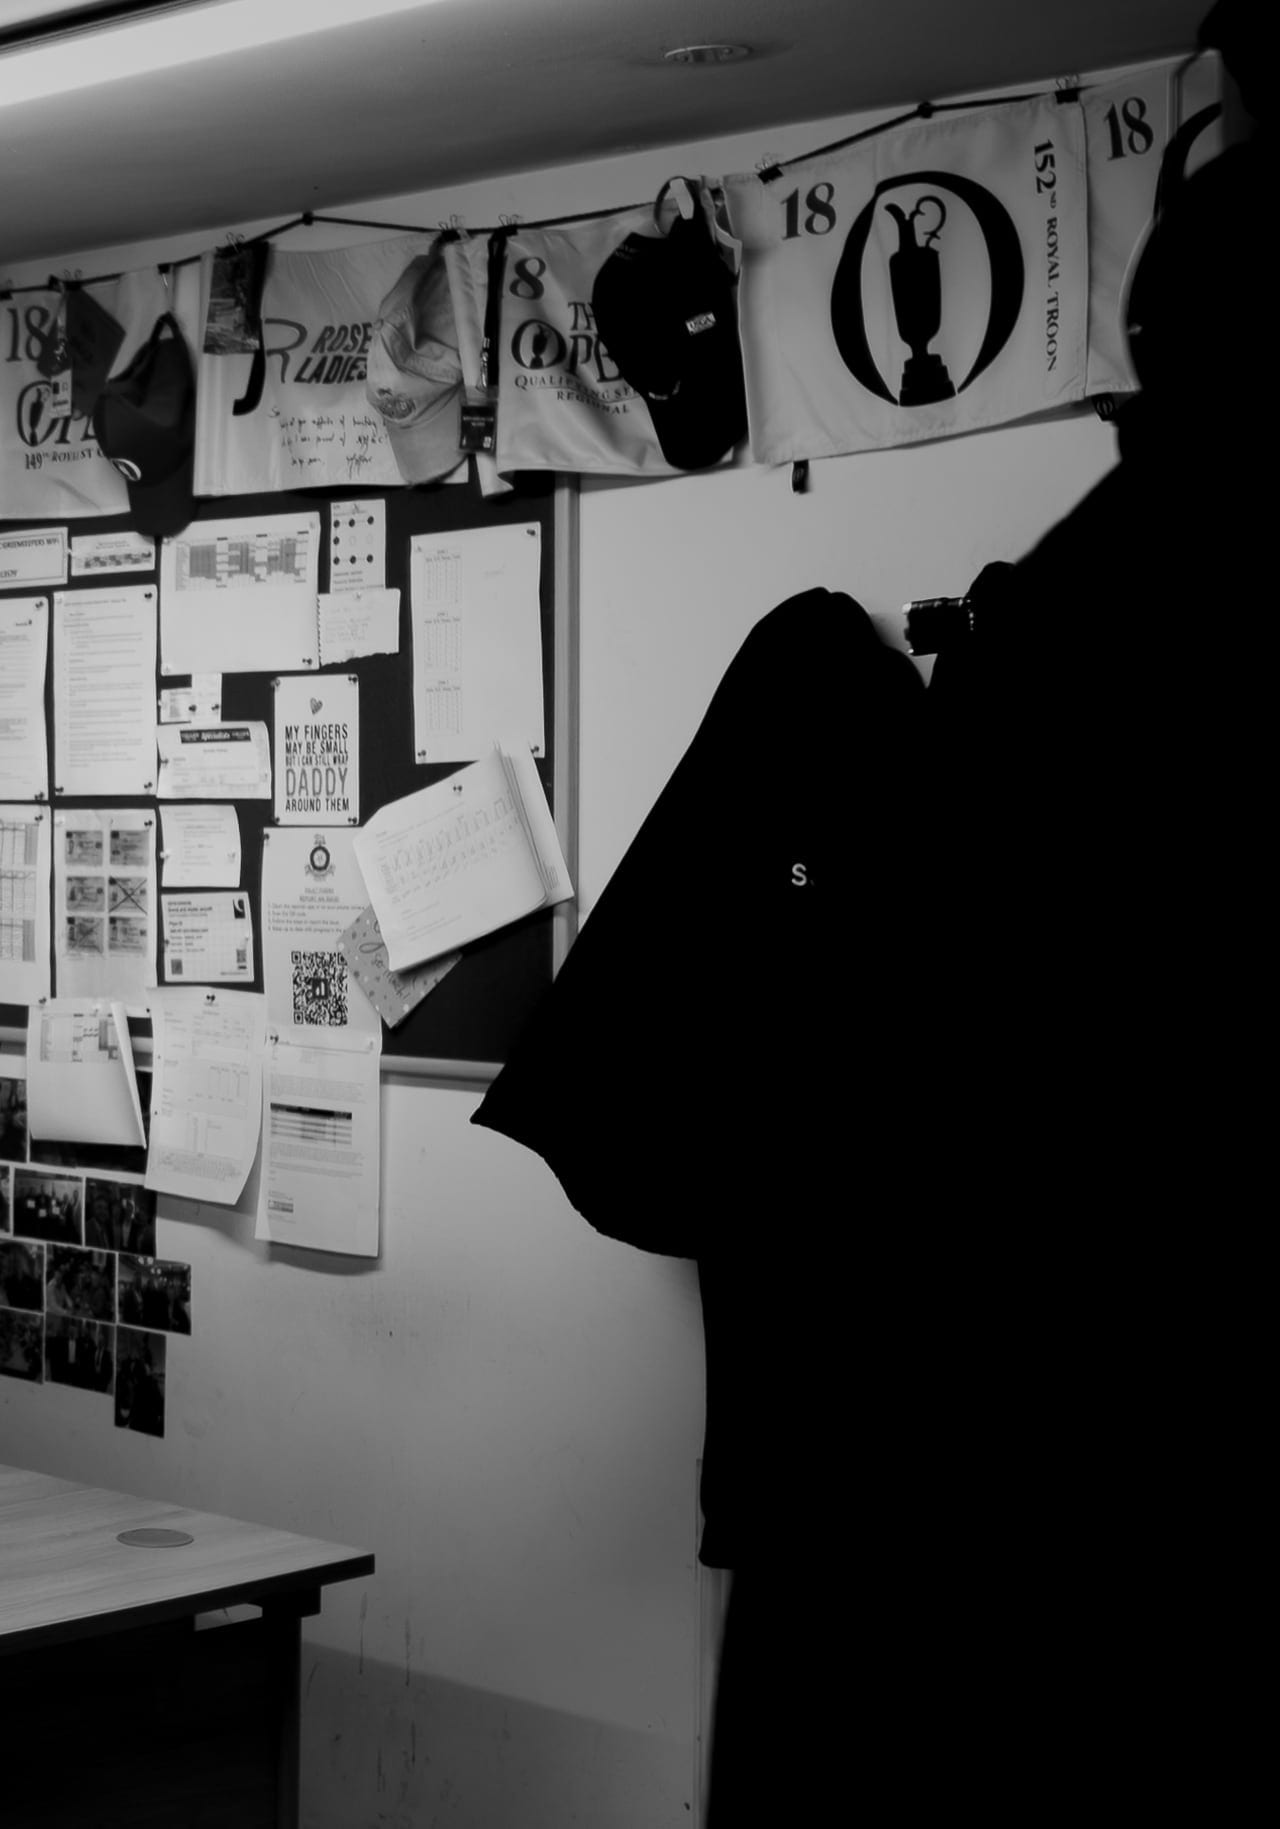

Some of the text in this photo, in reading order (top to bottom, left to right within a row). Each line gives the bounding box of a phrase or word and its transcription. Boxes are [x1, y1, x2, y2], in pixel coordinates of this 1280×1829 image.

[1104, 97, 1153, 161] 18
[781, 182, 837, 241] 18
[1045, 217, 1059, 289] ROYAL
[568, 302, 595, 331] TH
[6, 305, 52, 362] 18
[311, 321, 372, 354] ROSE
[1045, 293, 1059, 373] TROON
[511, 319, 623, 382] OPE
[295, 356, 368, 385] LADIES
[556, 391, 630, 414] REGIONAL
[285, 724, 348, 740] MY FINGERS
[285, 740, 348, 755] MAY BE SMALL
[285, 755, 296, 766] BUT
[302, 755, 313, 766] CAN
[315, 755, 330, 766] STILL
[333, 754, 349, 765] WRAP
[286, 767, 348, 796] DADDY
[285, 798, 350, 812] AROUND THEM
[792, 863, 807, 887] S
